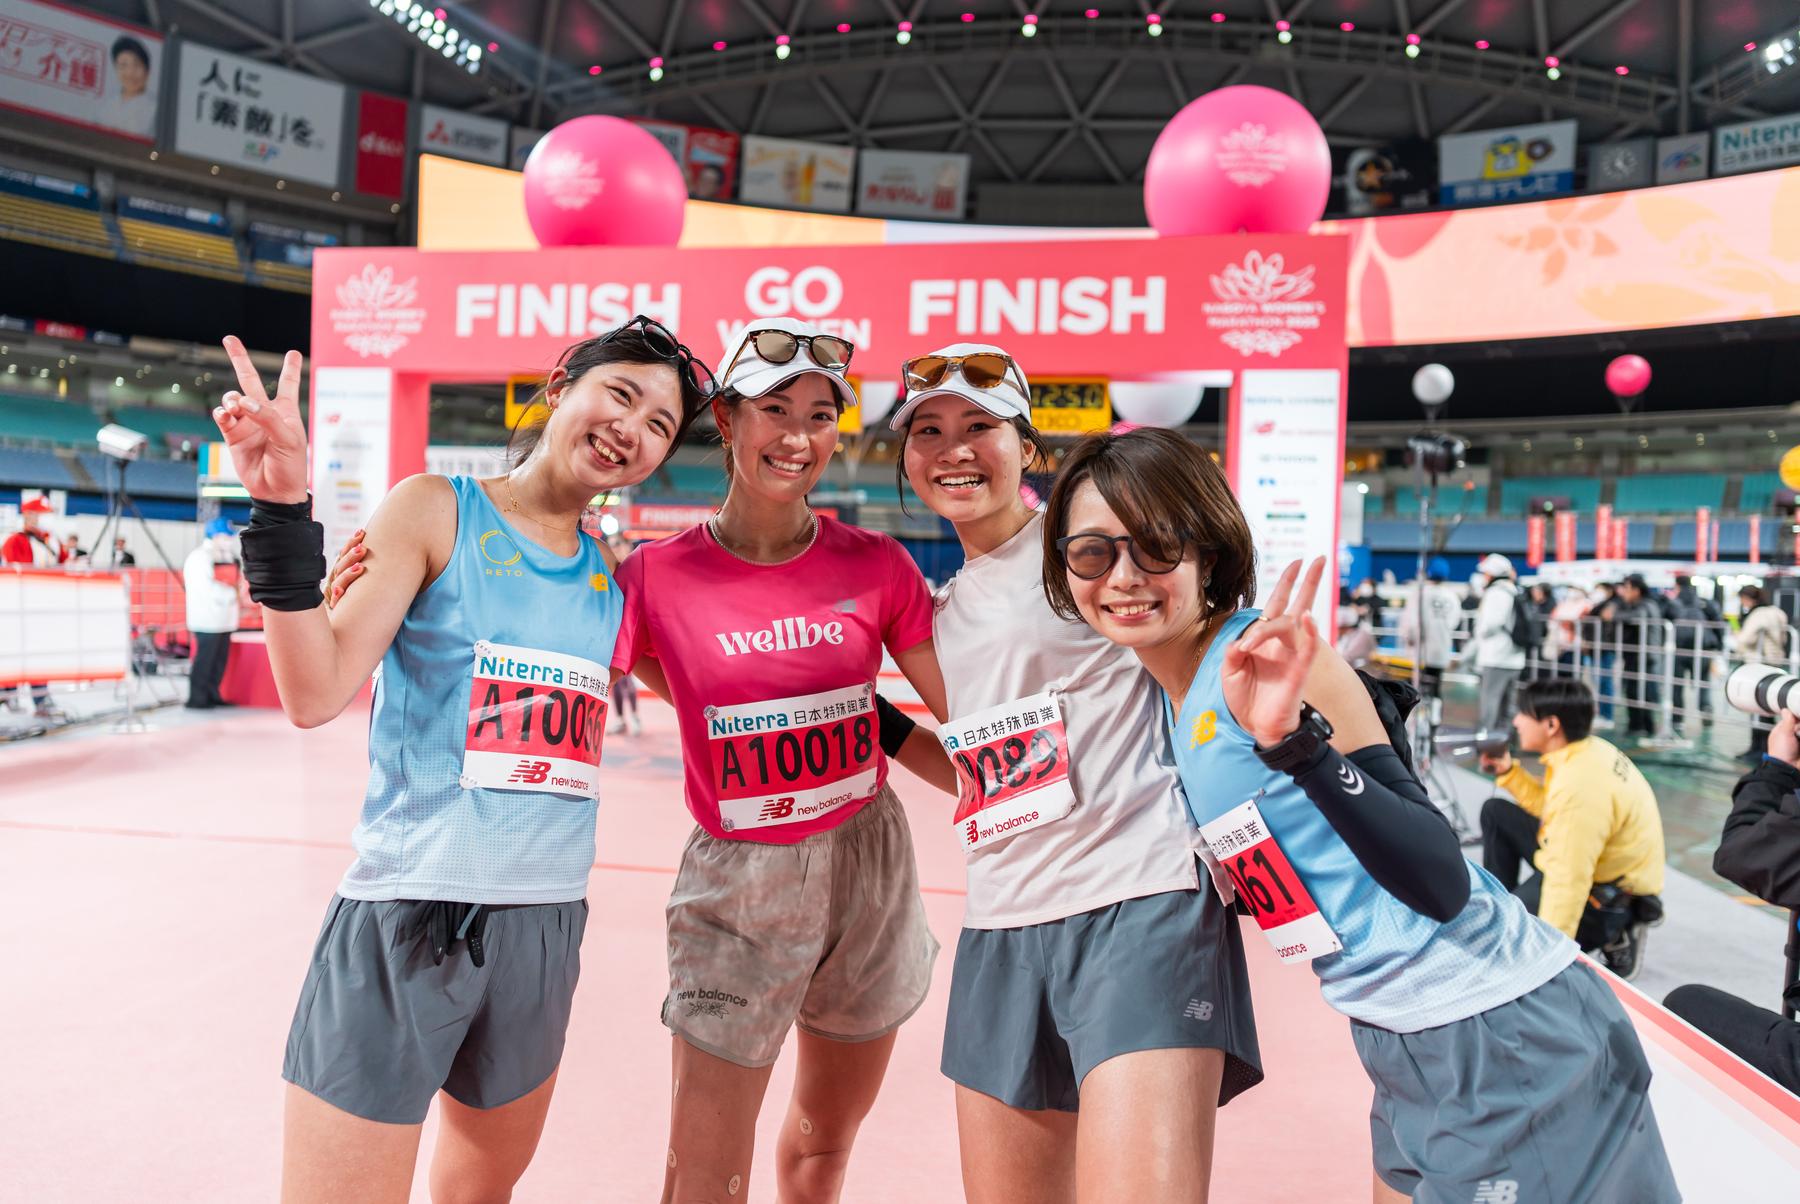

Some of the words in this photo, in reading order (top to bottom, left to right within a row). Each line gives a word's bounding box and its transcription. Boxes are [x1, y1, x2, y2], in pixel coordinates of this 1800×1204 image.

[200, 59, 262, 98] 人に
[456, 282, 681, 337] FINISH
[744, 265, 843, 317] GO
[908, 276, 1167, 335] FINISH
[485, 568, 525, 577] RETO
[716, 616, 844, 656] wellbe
[479, 656, 564, 684] Niterra
[712, 712, 789, 736] Niterra
[794, 696, 870, 725] 日本特殊陶業
[963, 704, 1055, 746] 日本特殊陶業
[721, 716, 873, 790] A10018
[551, 776, 570, 788] new
[797, 804, 818, 816] new
[819, 792, 853, 810] balance
[979, 826, 995, 839] new
[995, 809, 1039, 833] balance
[1276, 941, 1308, 959] balance
[677, 990, 696, 1001] new
[698, 988, 748, 1007] balance
